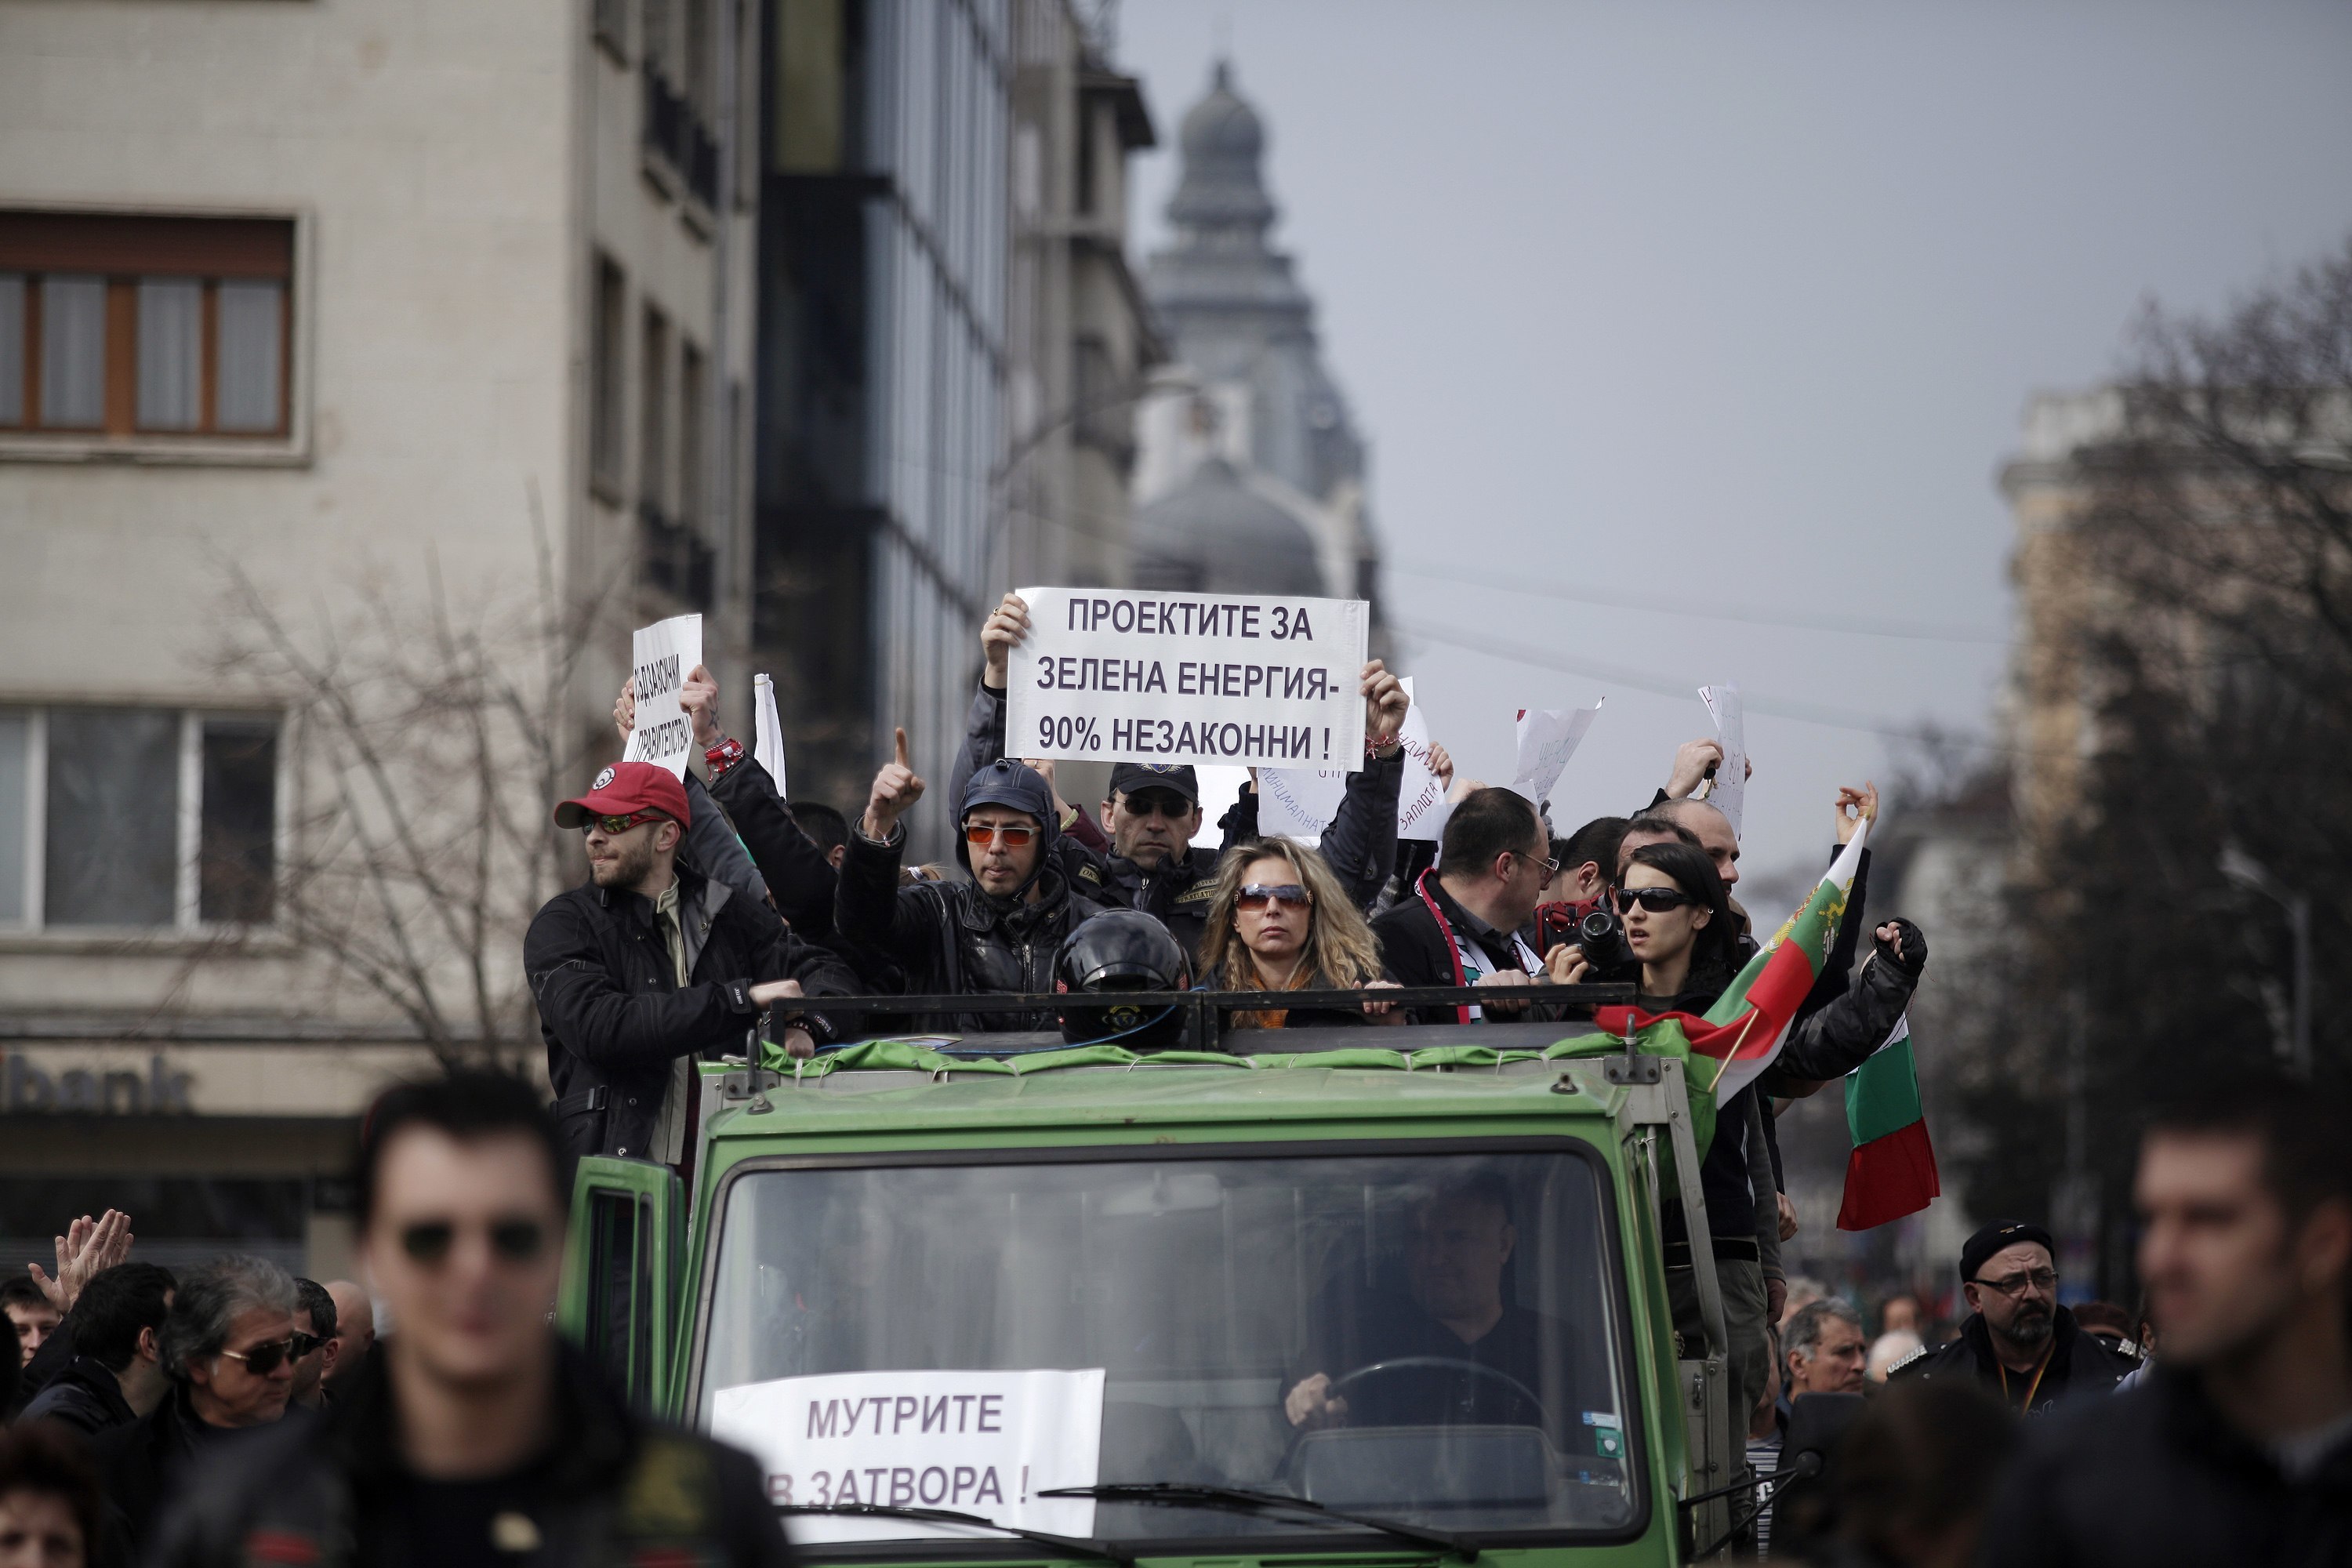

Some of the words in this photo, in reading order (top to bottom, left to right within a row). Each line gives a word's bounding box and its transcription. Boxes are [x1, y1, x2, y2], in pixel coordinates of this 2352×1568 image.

[1068, 598, 1261, 639] ПРОЕКТИТЕ
[1270, 606, 1313, 641] ЗА
[1036, 656, 1167, 694] ЗЕЛЕНА
[1178, 662, 1340, 701] ЕНЕРГИЯ-
[632, 718, 688, 762] ПРАВИТЕЛСТВА
[1039, 716, 1101, 752] 90%
[1112, 718, 1312, 760] НЕЗАКОННИ
[1262, 768, 1327, 833] ИНИМАЛНАТ
[807, 1395, 1004, 1439] МУТРИТЕ
[808, 1465, 1004, 1508] ЗАТВОРА
